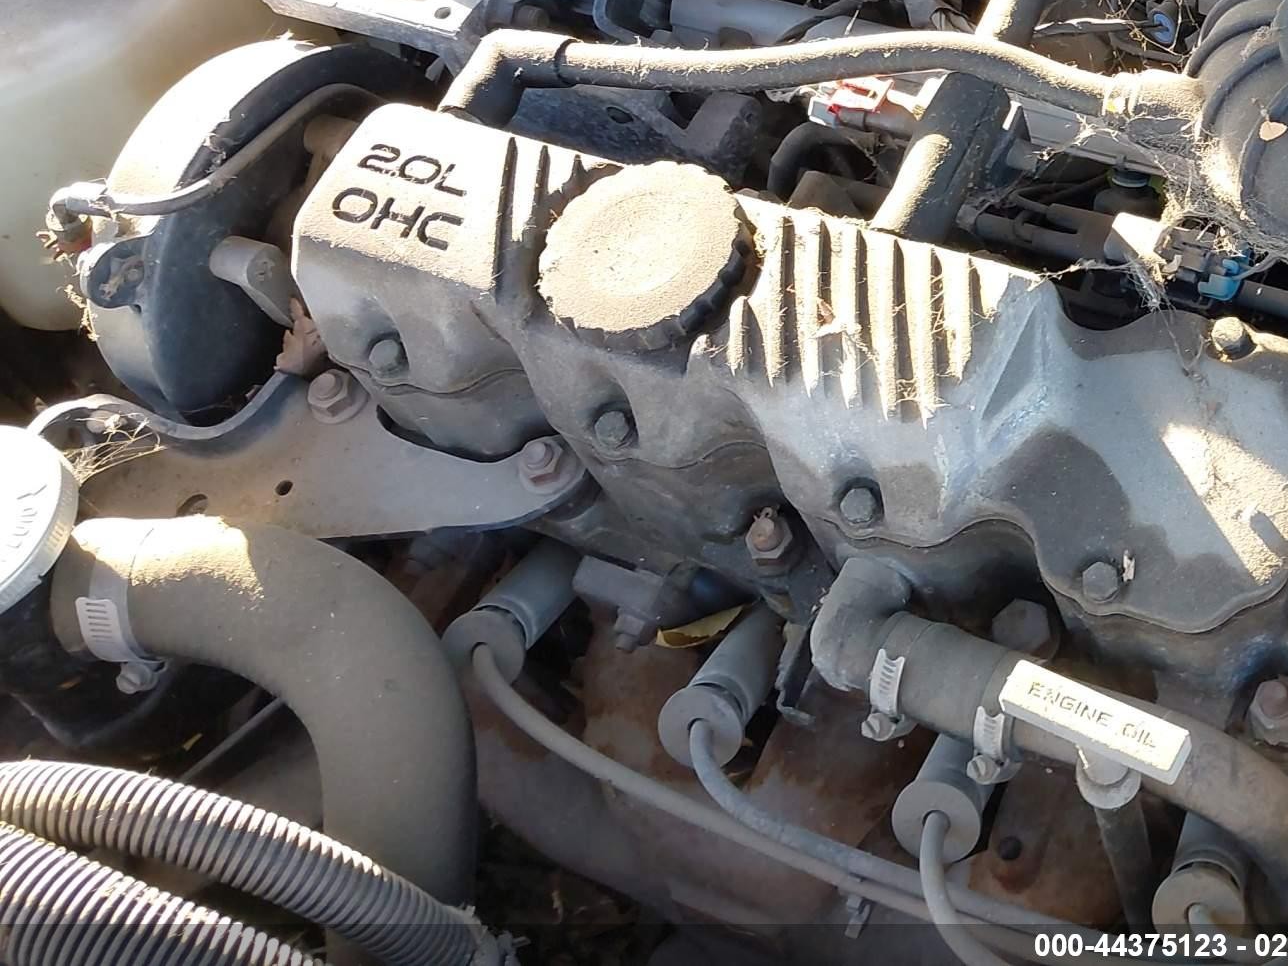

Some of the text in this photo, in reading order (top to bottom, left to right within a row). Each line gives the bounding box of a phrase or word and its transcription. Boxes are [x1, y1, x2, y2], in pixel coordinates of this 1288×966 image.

[332, 186, 465, 251] OHC
[1027, 682, 1157, 749] ENGINE OIL
